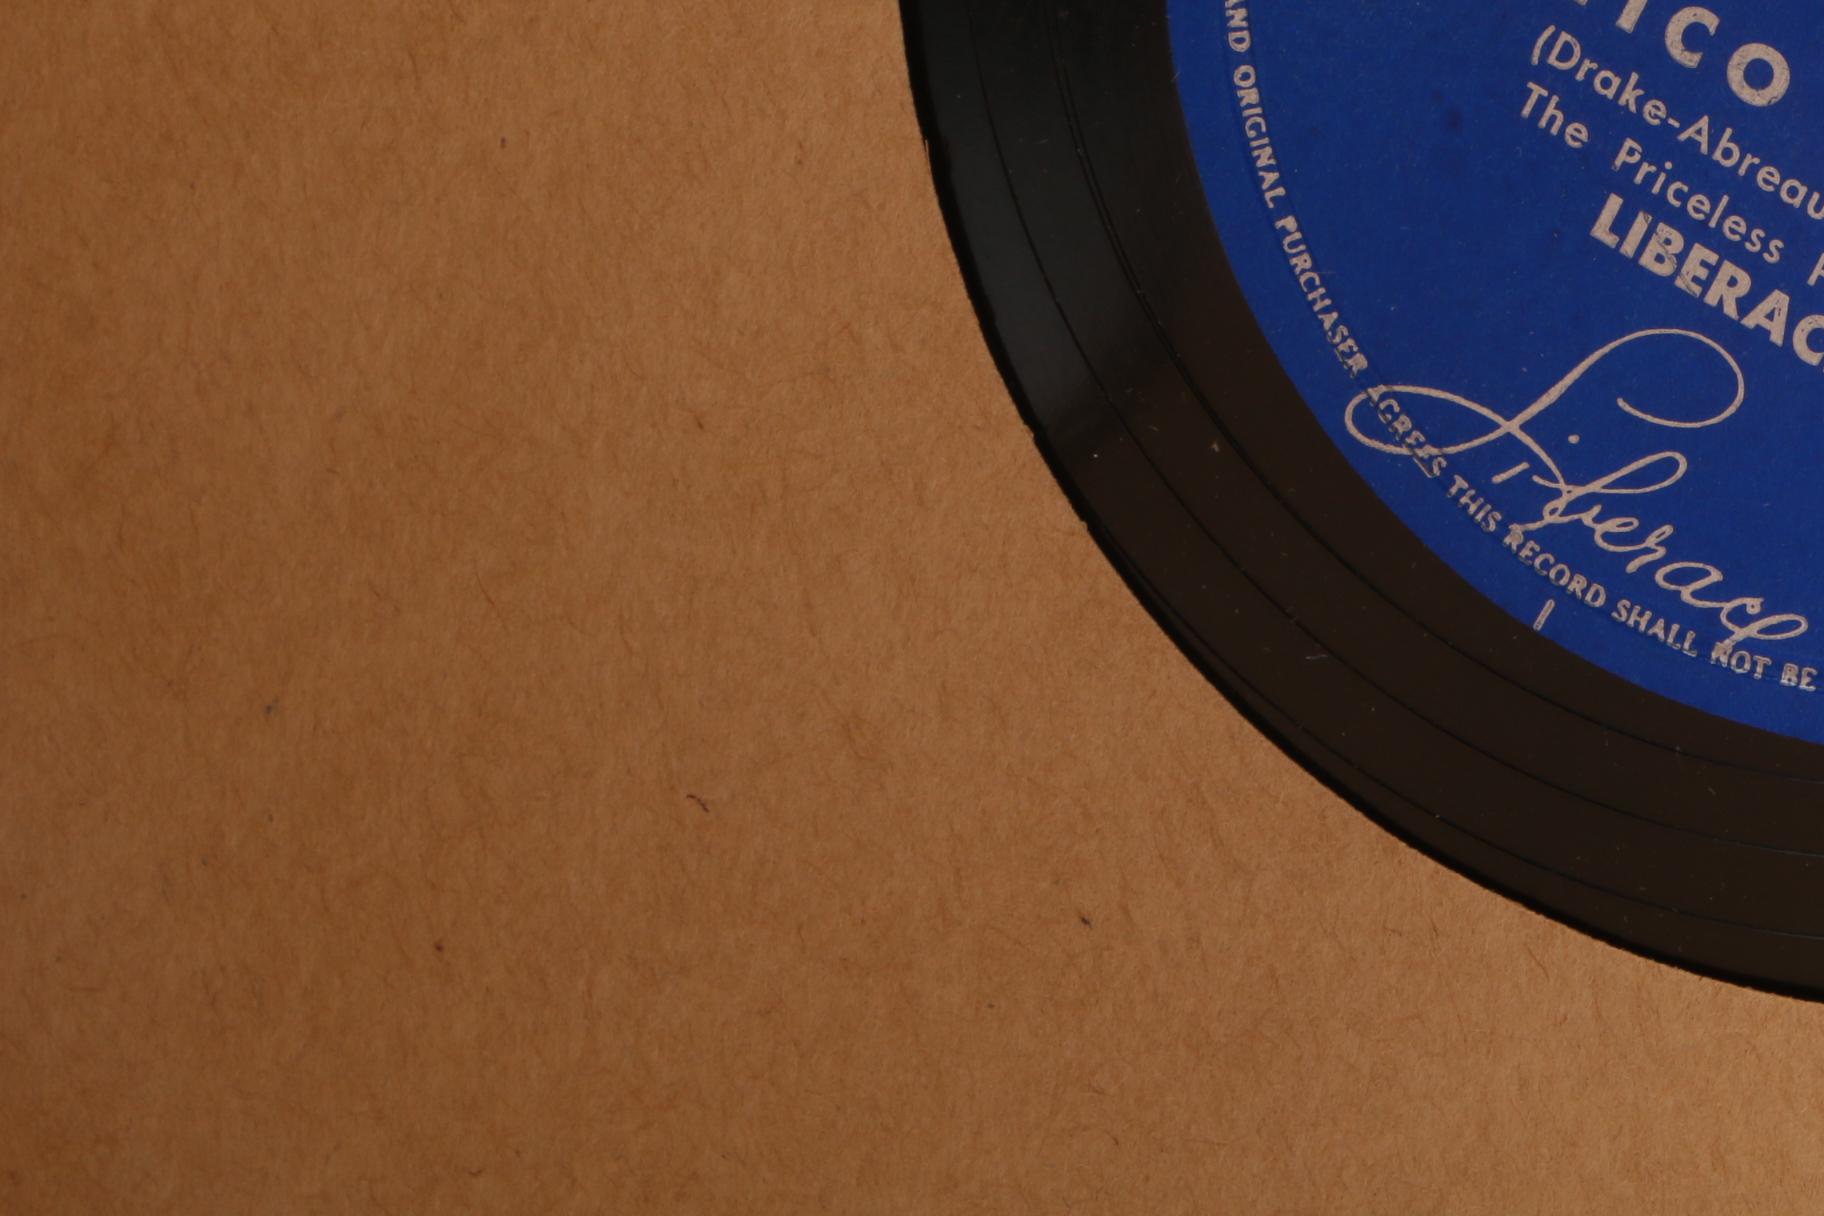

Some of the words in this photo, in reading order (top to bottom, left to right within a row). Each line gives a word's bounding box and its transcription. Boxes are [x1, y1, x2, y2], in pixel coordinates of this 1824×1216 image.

[1520, 82, 1590, 149] The
[1613, 139, 1785, 265] Priceless
[1233, 62, 1287, 209] ORIGINAL
[1275, 215, 1369, 379] PURCHASER
[1446, 474, 1503, 533] THIS
[1502, 523, 1607, 608] RECORD
[1611, 599, 1698, 657] SHALL
[1710, 641, 1772, 680] NOT
[1779, 663, 1818, 693] BE
